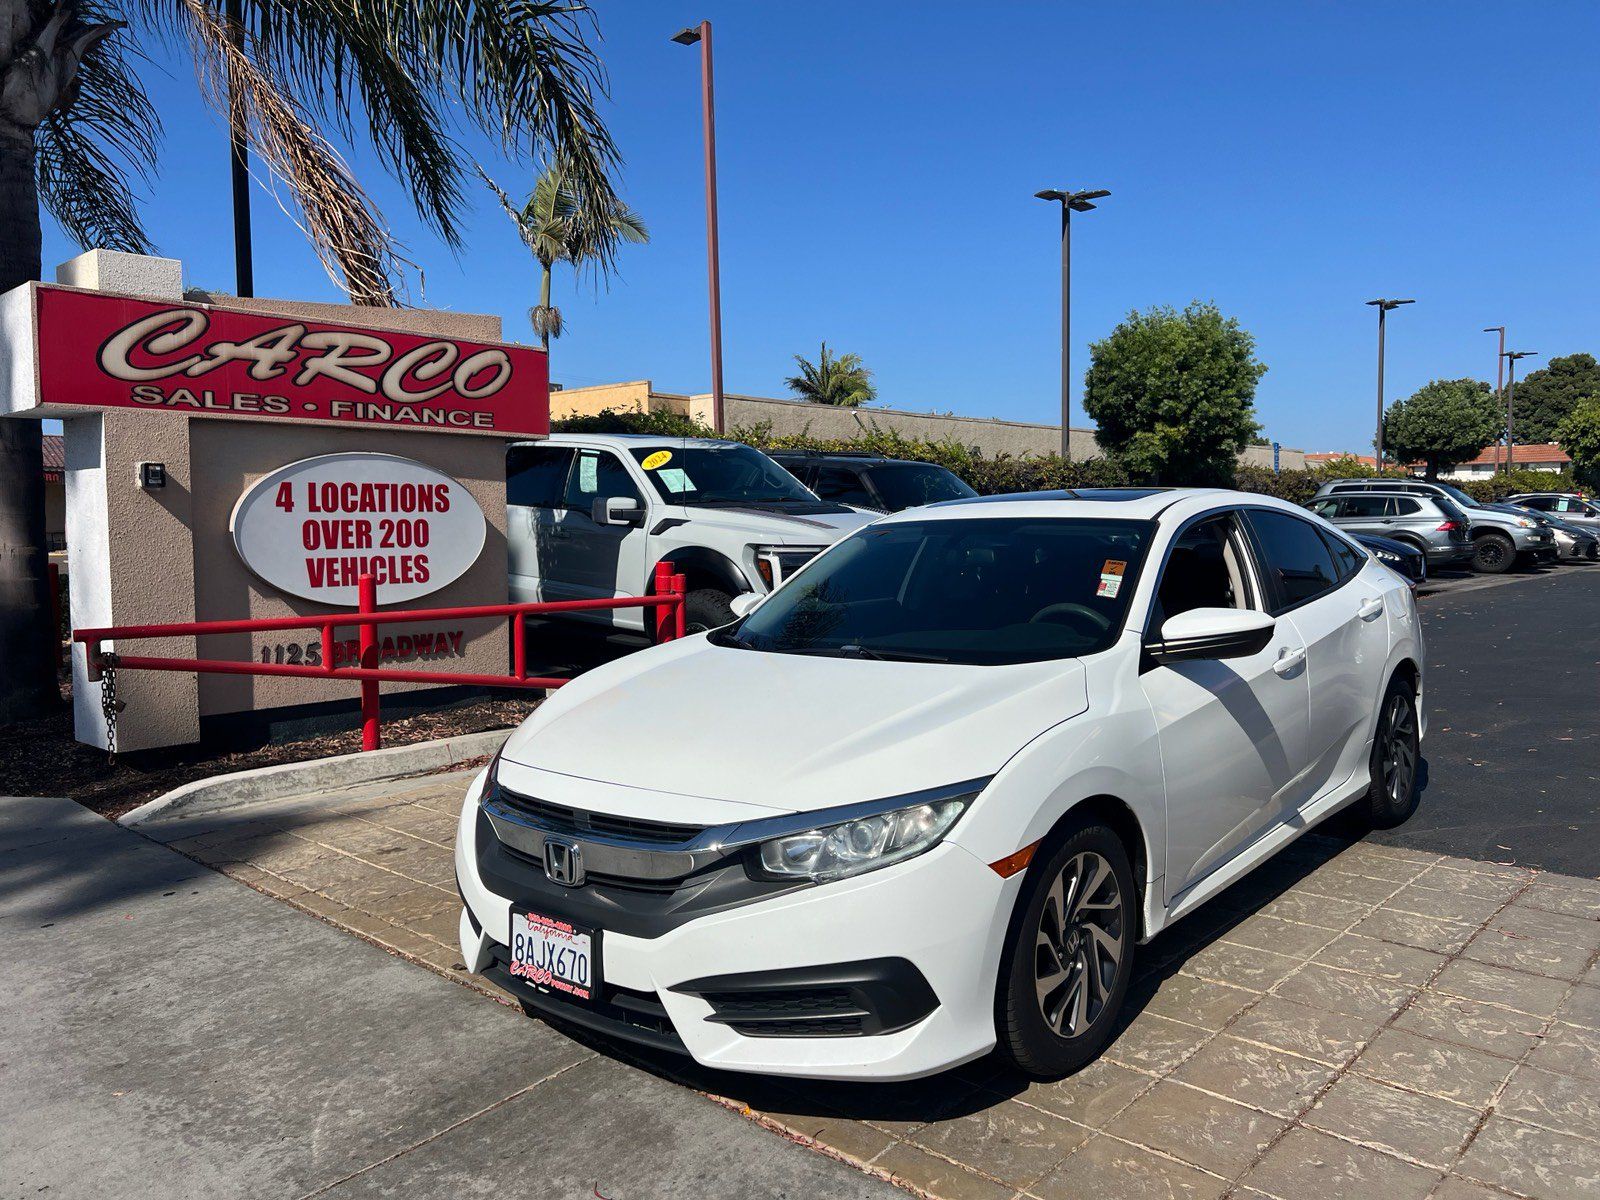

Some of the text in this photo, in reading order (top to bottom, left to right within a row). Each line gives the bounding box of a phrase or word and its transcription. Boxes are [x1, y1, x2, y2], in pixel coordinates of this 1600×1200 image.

[98, 309, 512, 402] CARCO
[132, 385, 494, 428] SALES FINANCE
[275, 482, 450, 513] 4 LOCATIONS
[302, 519, 430, 550] OVER 200
[261, 631, 463, 665] 1125 BRADWAY
[510, 960, 552, 984] CARCO
[515, 933, 587, 984] 8AJX670
